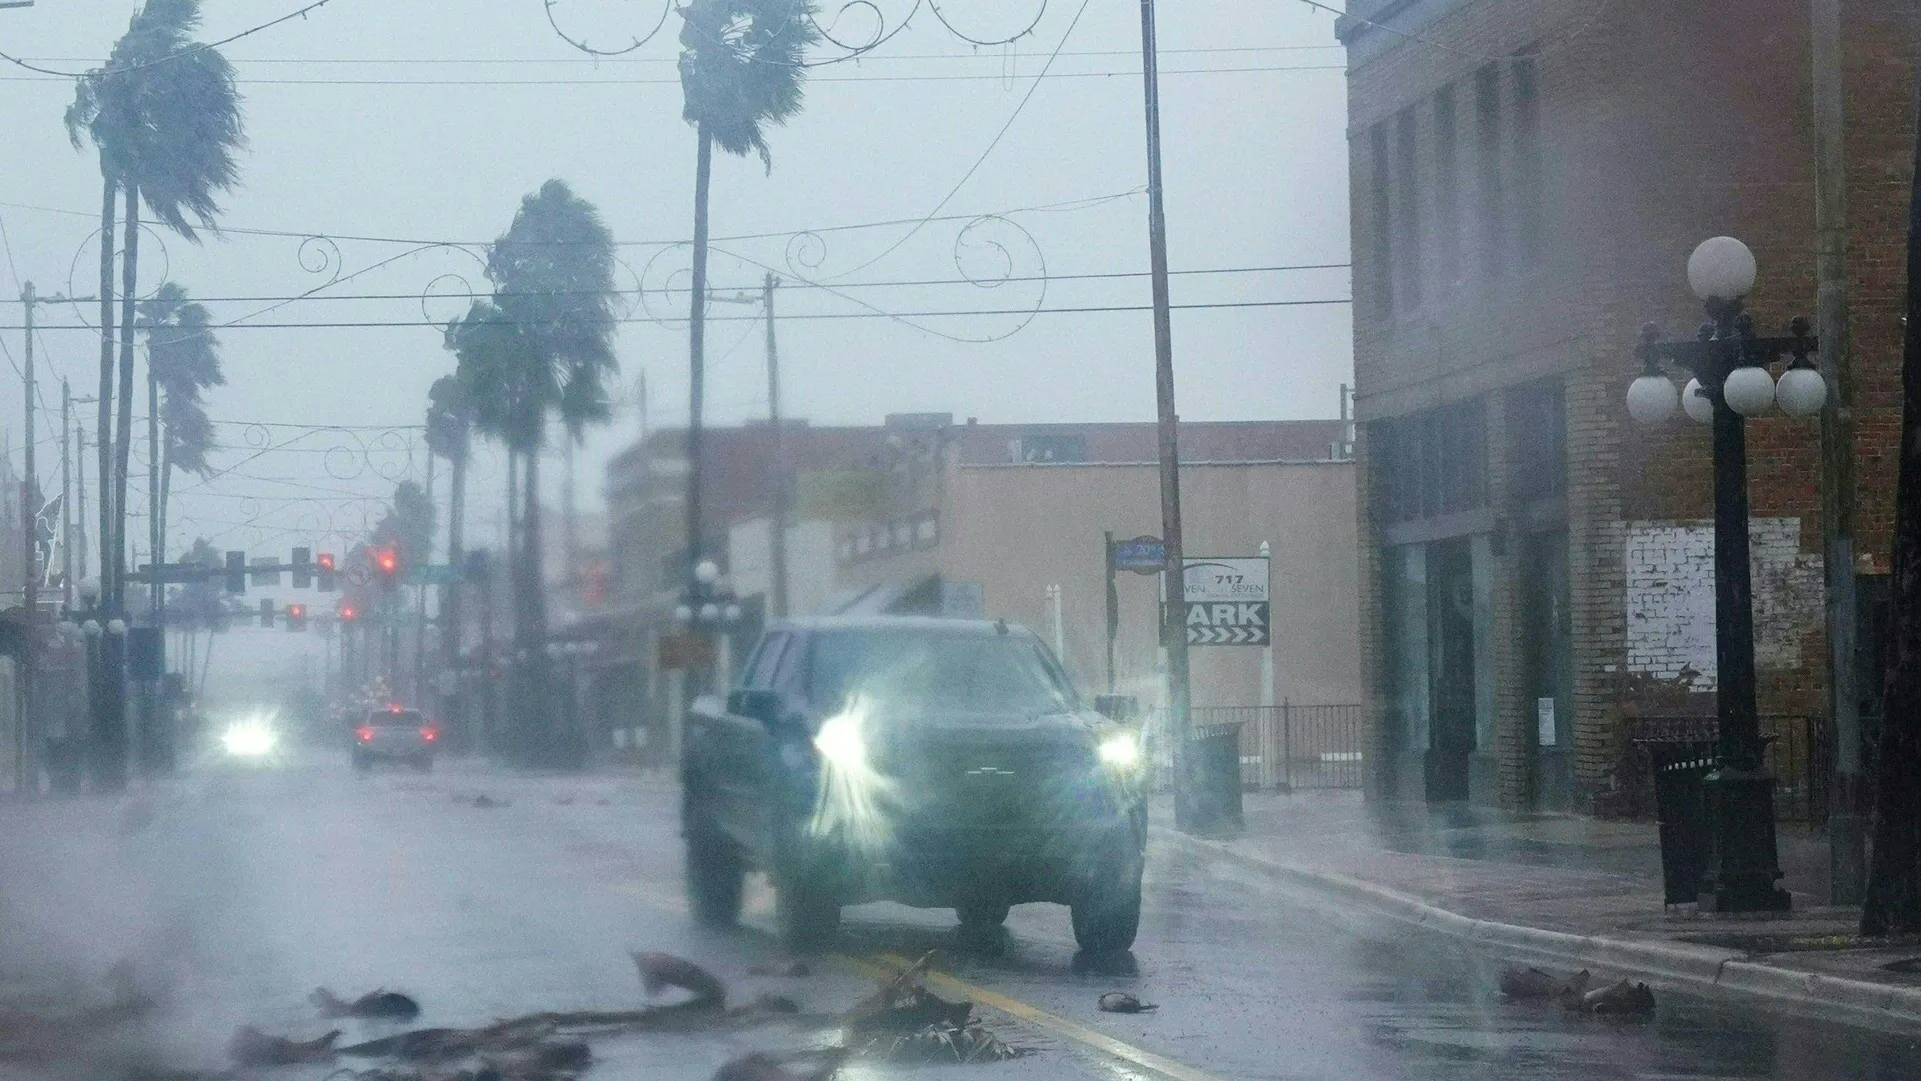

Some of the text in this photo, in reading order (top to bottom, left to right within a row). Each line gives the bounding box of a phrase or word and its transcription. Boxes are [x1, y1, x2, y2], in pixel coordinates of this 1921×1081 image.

[1215, 575, 1244, 584] 717
[1183, 584, 1264, 593] VEN SEVEN
[1164, 603, 1265, 626] ARK
